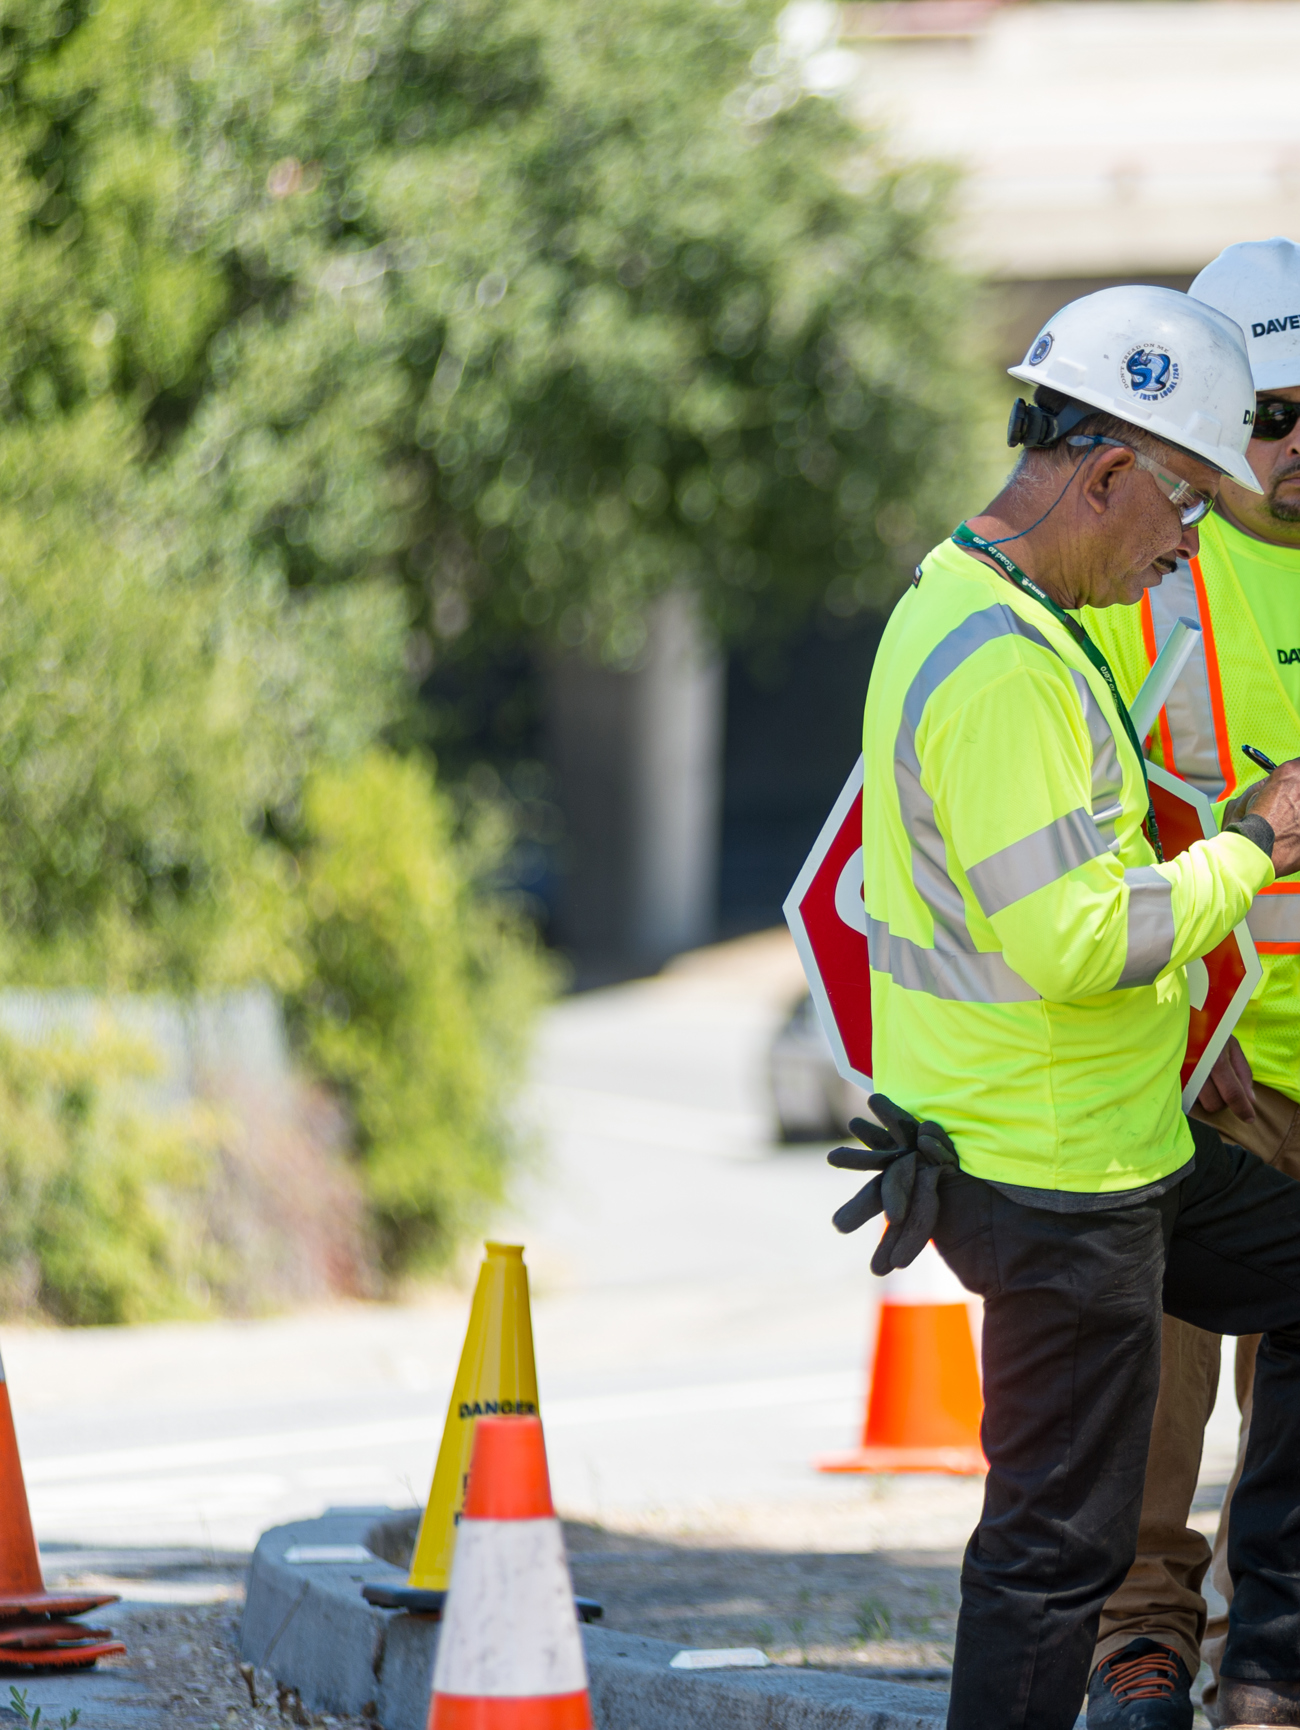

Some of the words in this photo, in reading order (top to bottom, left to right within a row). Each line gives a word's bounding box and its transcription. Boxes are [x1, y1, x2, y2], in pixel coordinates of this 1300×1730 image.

[1122, 345, 1141, 364] TREAD
[1156, 345, 1169, 353] ME
[1120, 366, 1129, 389] DON'T
[1160, 381, 1177, 398] LOCAL
[988, 546, 997, 554] to
[995, 552, 1015, 572] Road
[1028, 582, 1046, 599] DAVEY
[1100, 666, 1112, 682] Zero
[459, 1400, 536, 1419] DANGER
